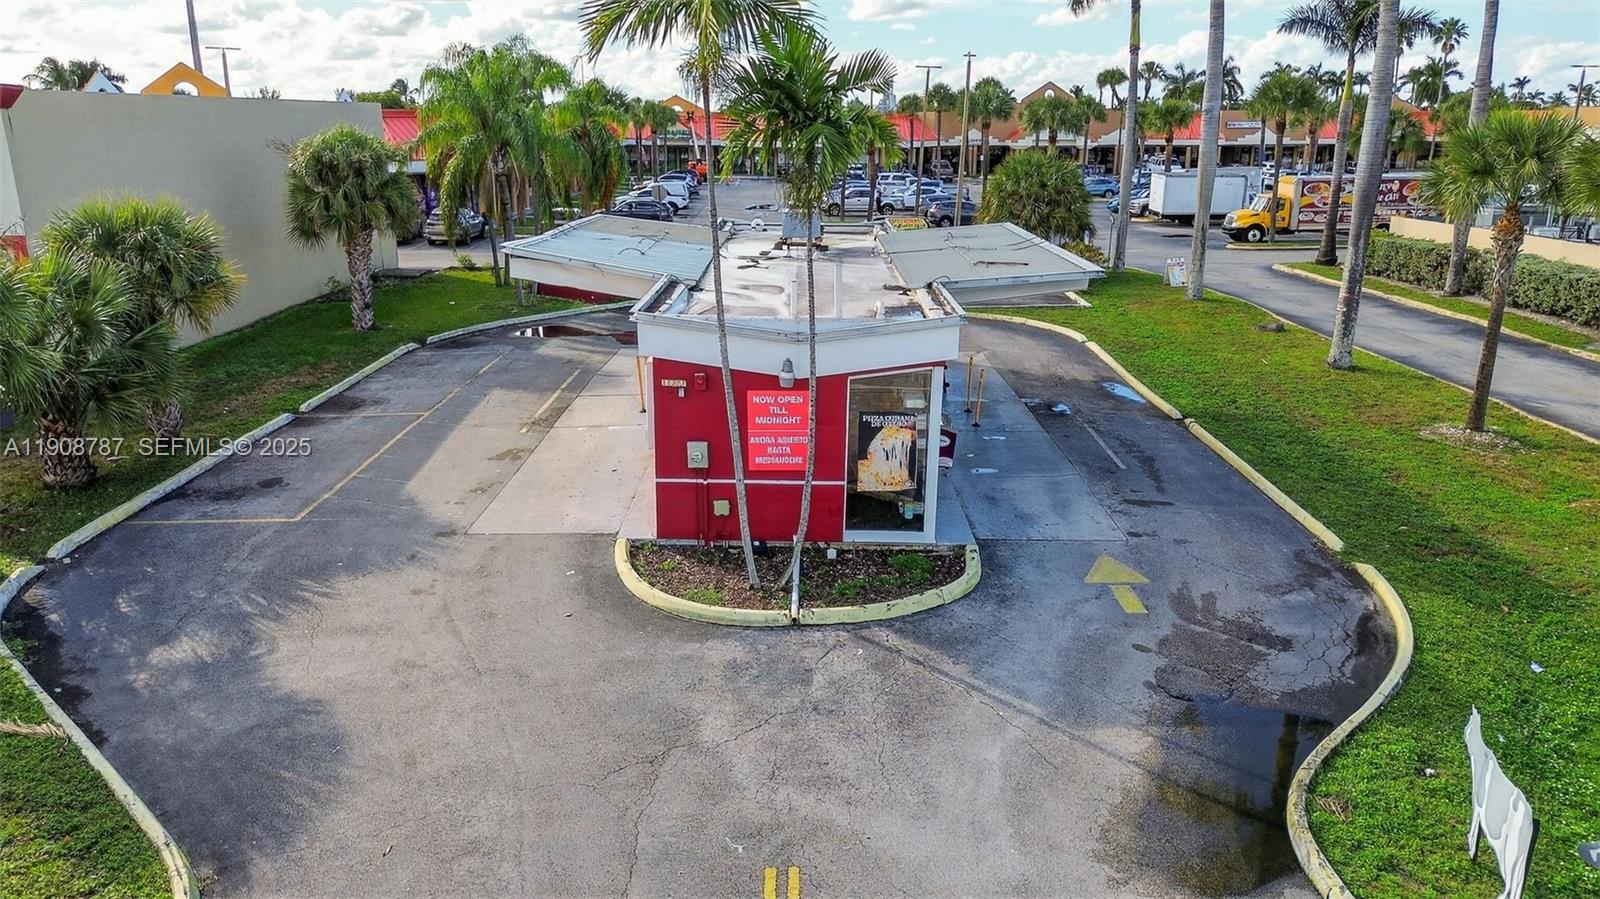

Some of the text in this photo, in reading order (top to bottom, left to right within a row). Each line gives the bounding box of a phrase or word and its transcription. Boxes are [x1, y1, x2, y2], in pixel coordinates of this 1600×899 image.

[752, 395, 803, 404] NOW OPEN
[768, 406, 789, 414] TILL
[755, 416, 802, 424] MIDNIGHT
